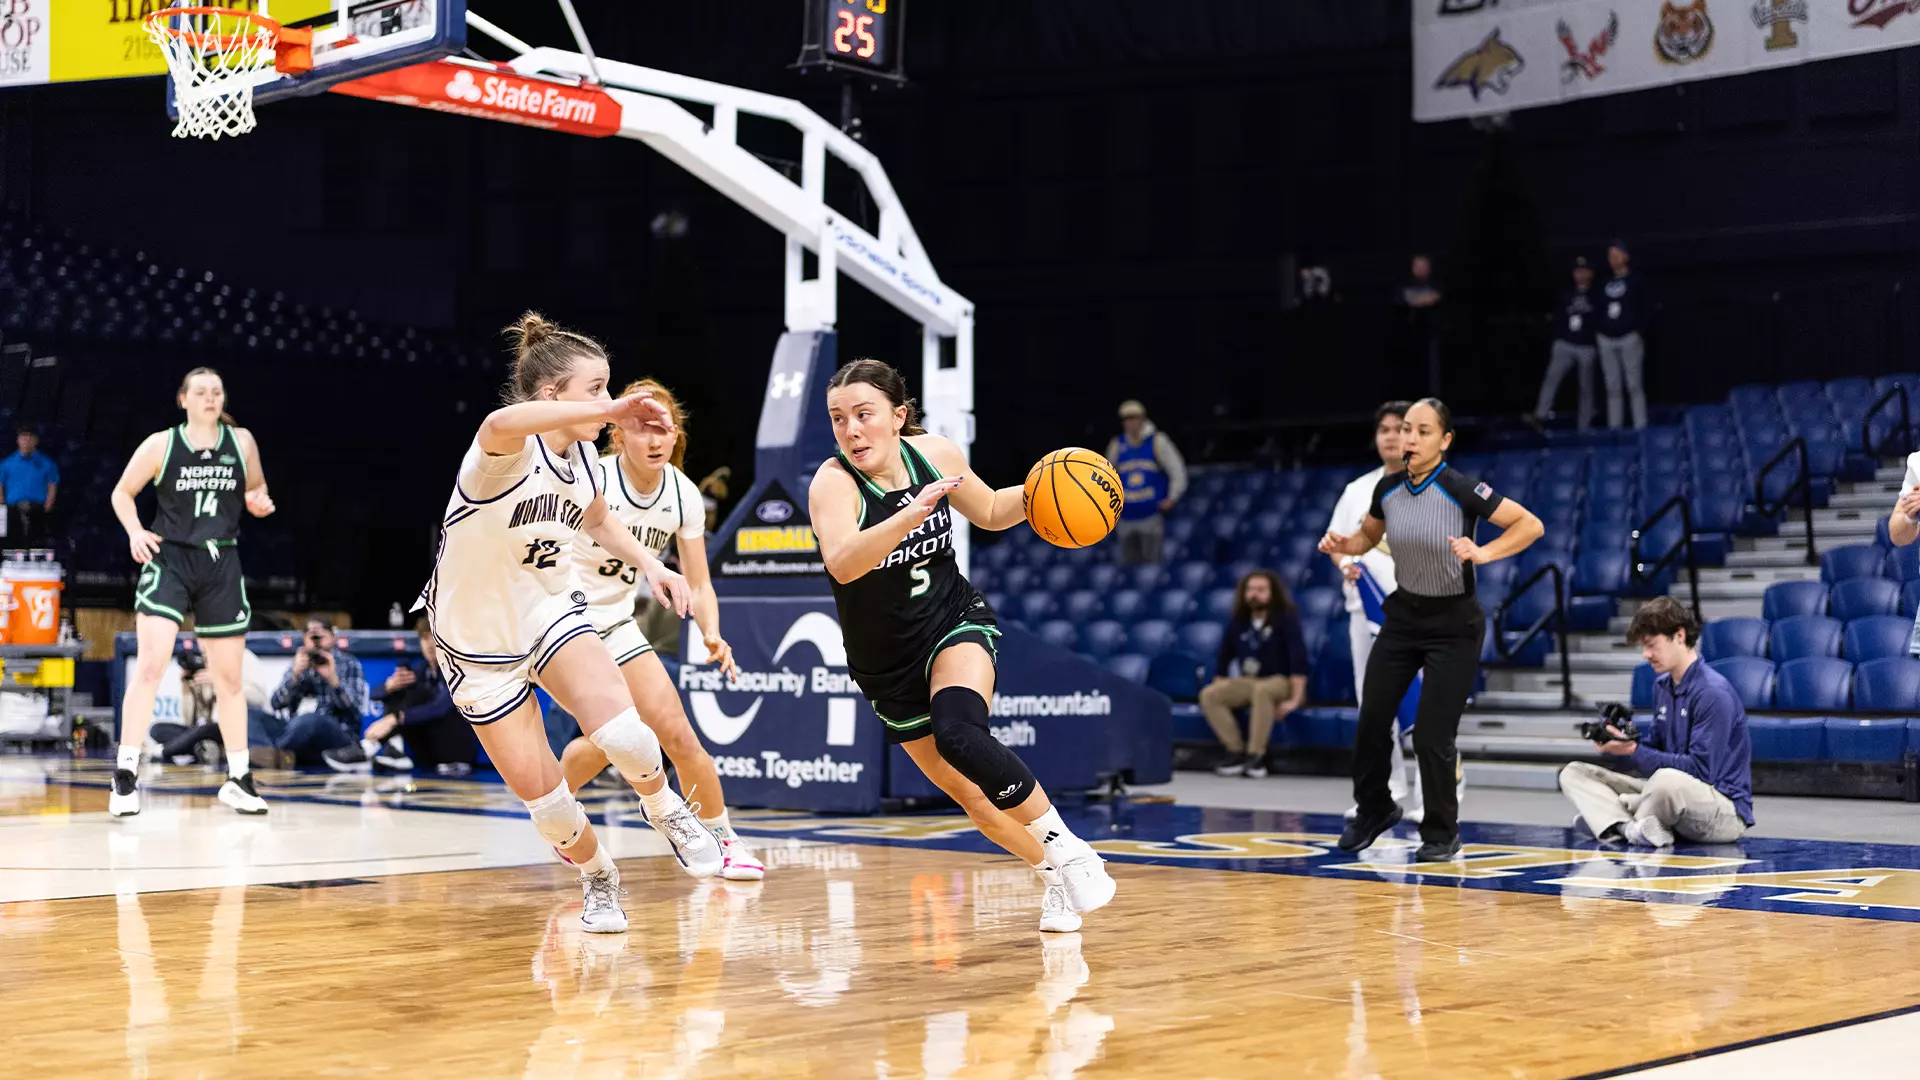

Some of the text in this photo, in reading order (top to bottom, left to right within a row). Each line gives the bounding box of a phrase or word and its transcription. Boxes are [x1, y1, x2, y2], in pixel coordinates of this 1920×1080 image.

[834, 9, 876, 58] 25
[175, 478, 237, 492] DAKOTA
[180, 465, 234, 479] NORTH
[194, 490, 218, 518] 14
[508, 493, 560, 529] MONTANA
[522, 538, 560, 569] 12
[736, 526, 817, 554] KENDALL
[910, 557, 931, 599] 5
[679, 664, 723, 691] First
[726, 666, 806, 698] Security
[760, 750, 864, 788] Together
